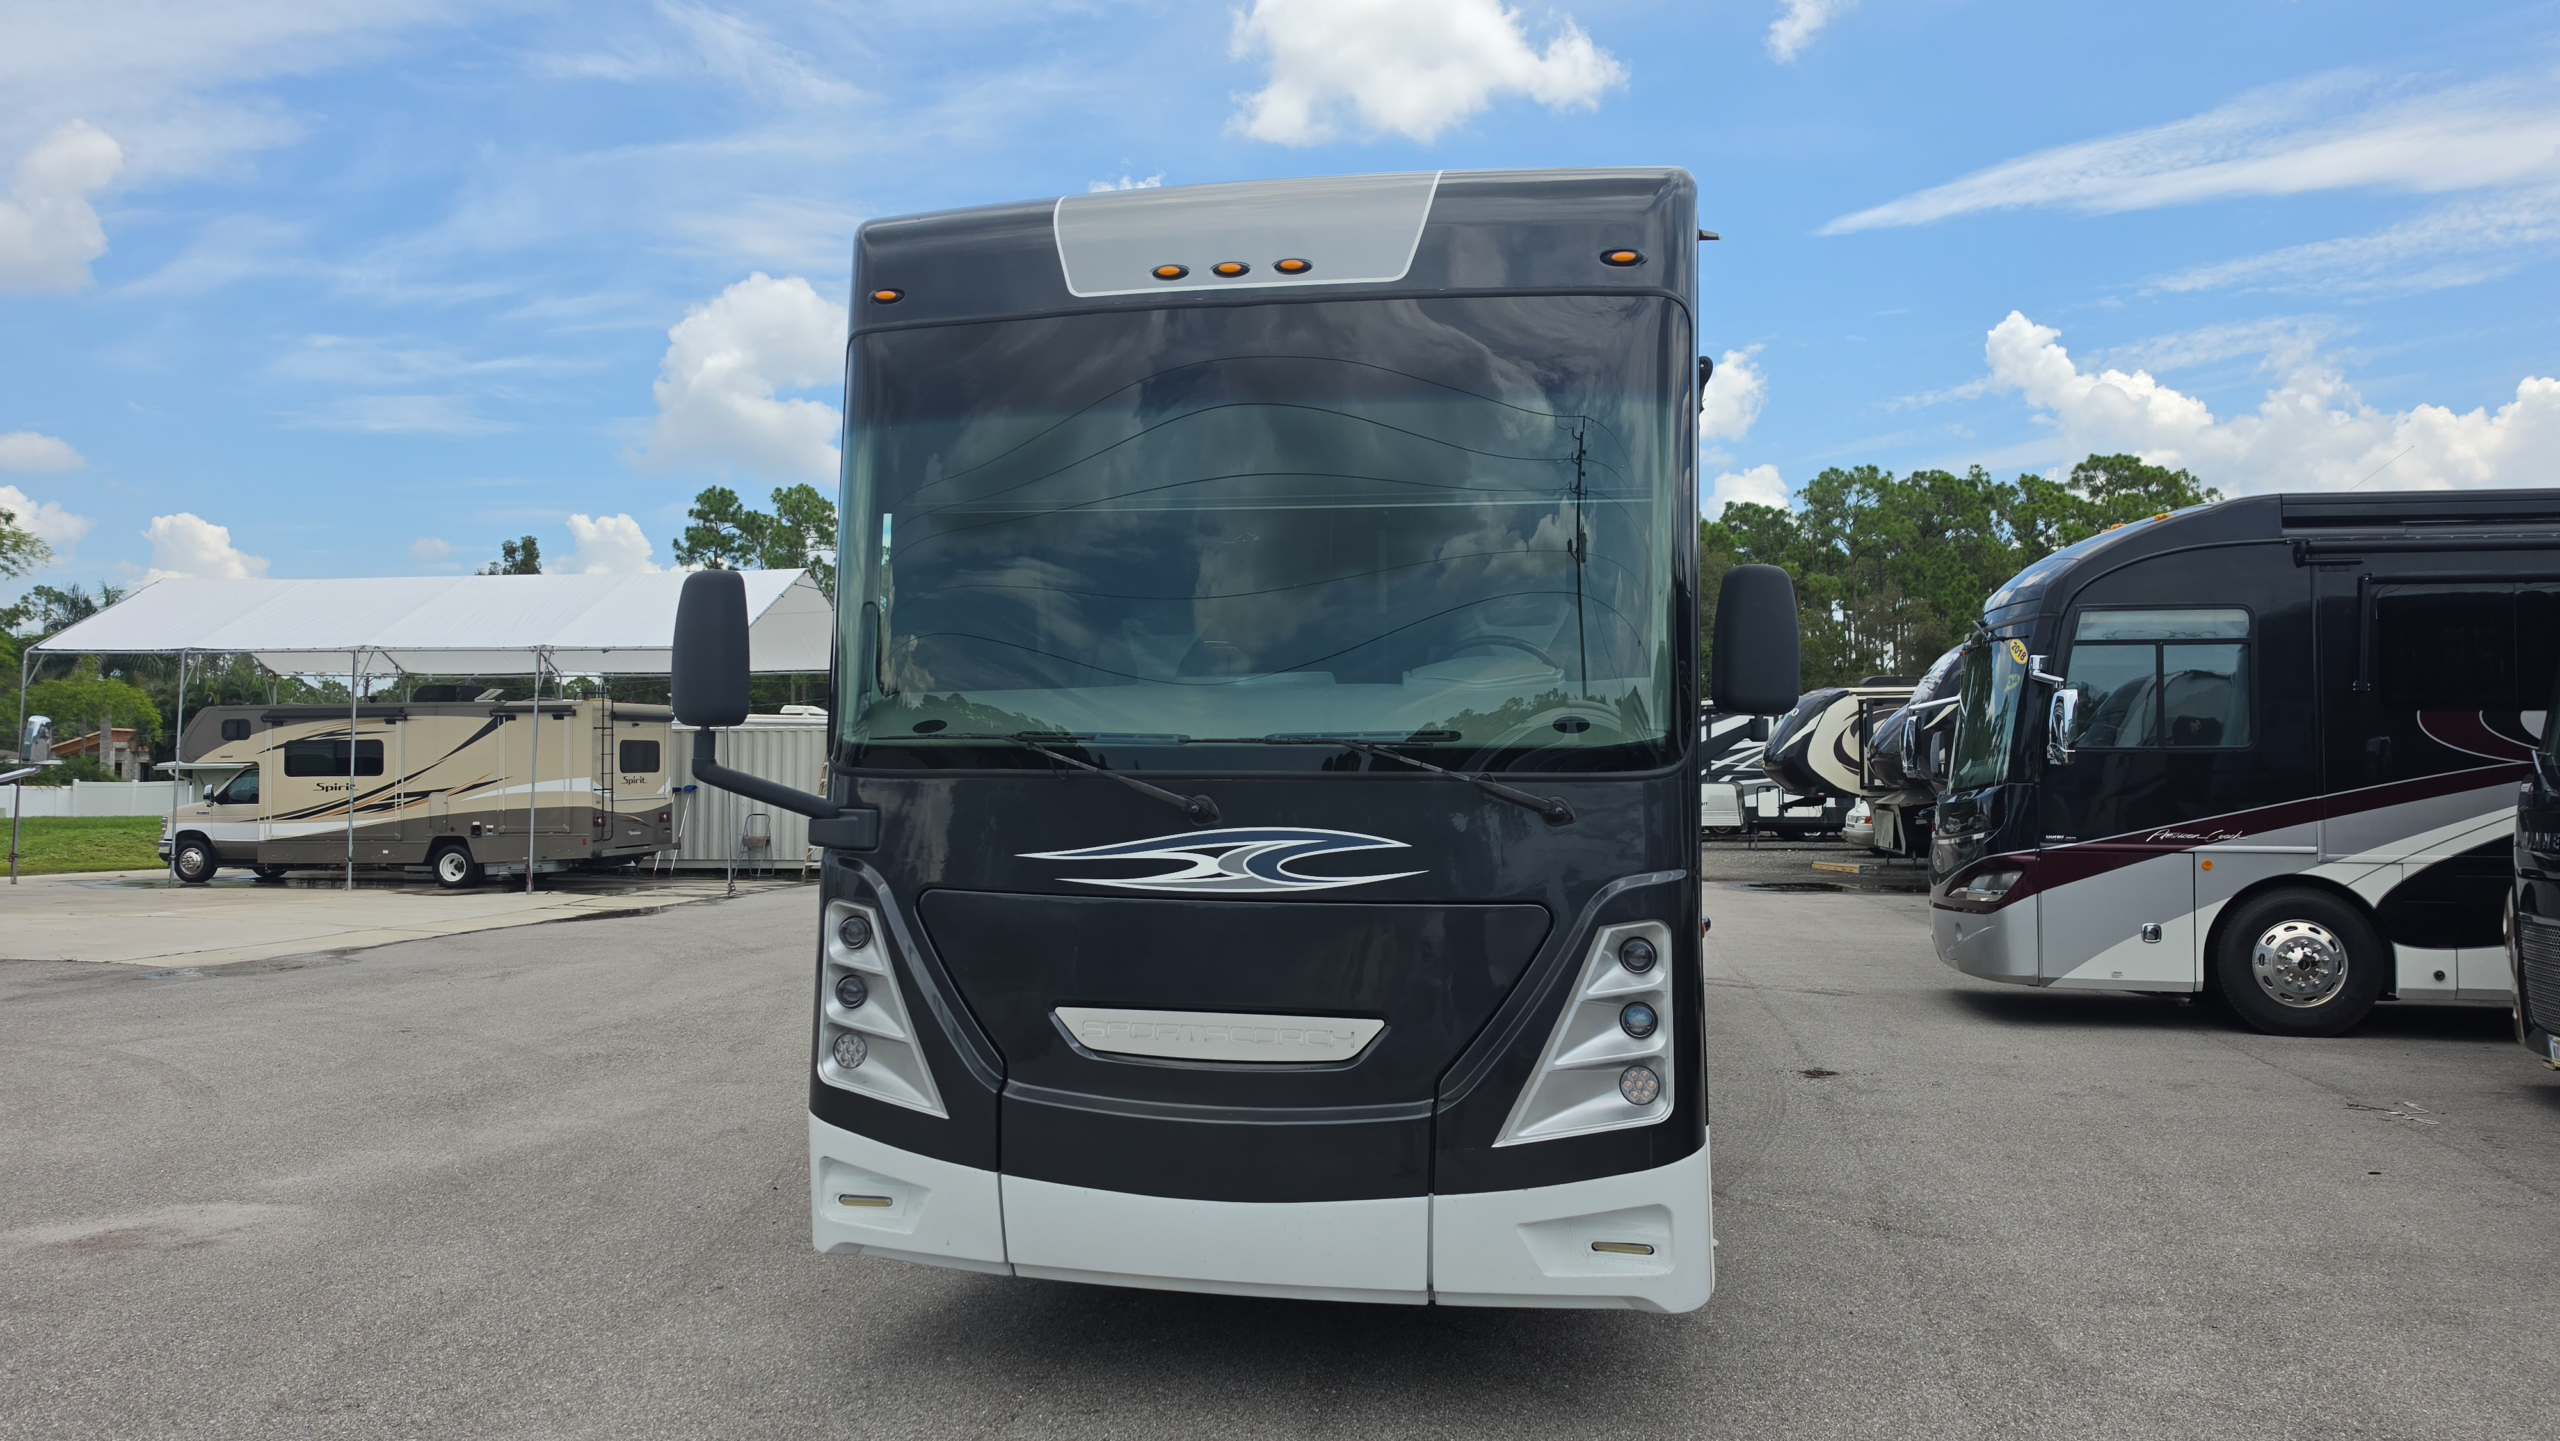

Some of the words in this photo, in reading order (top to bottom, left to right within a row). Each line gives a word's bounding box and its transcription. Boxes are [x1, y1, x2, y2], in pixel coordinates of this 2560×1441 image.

[2011, 641, 2027, 661] 2018
[621, 775, 648, 785] Spirit
[1081, 1019, 1355, 1049] SPORTSCOACH
